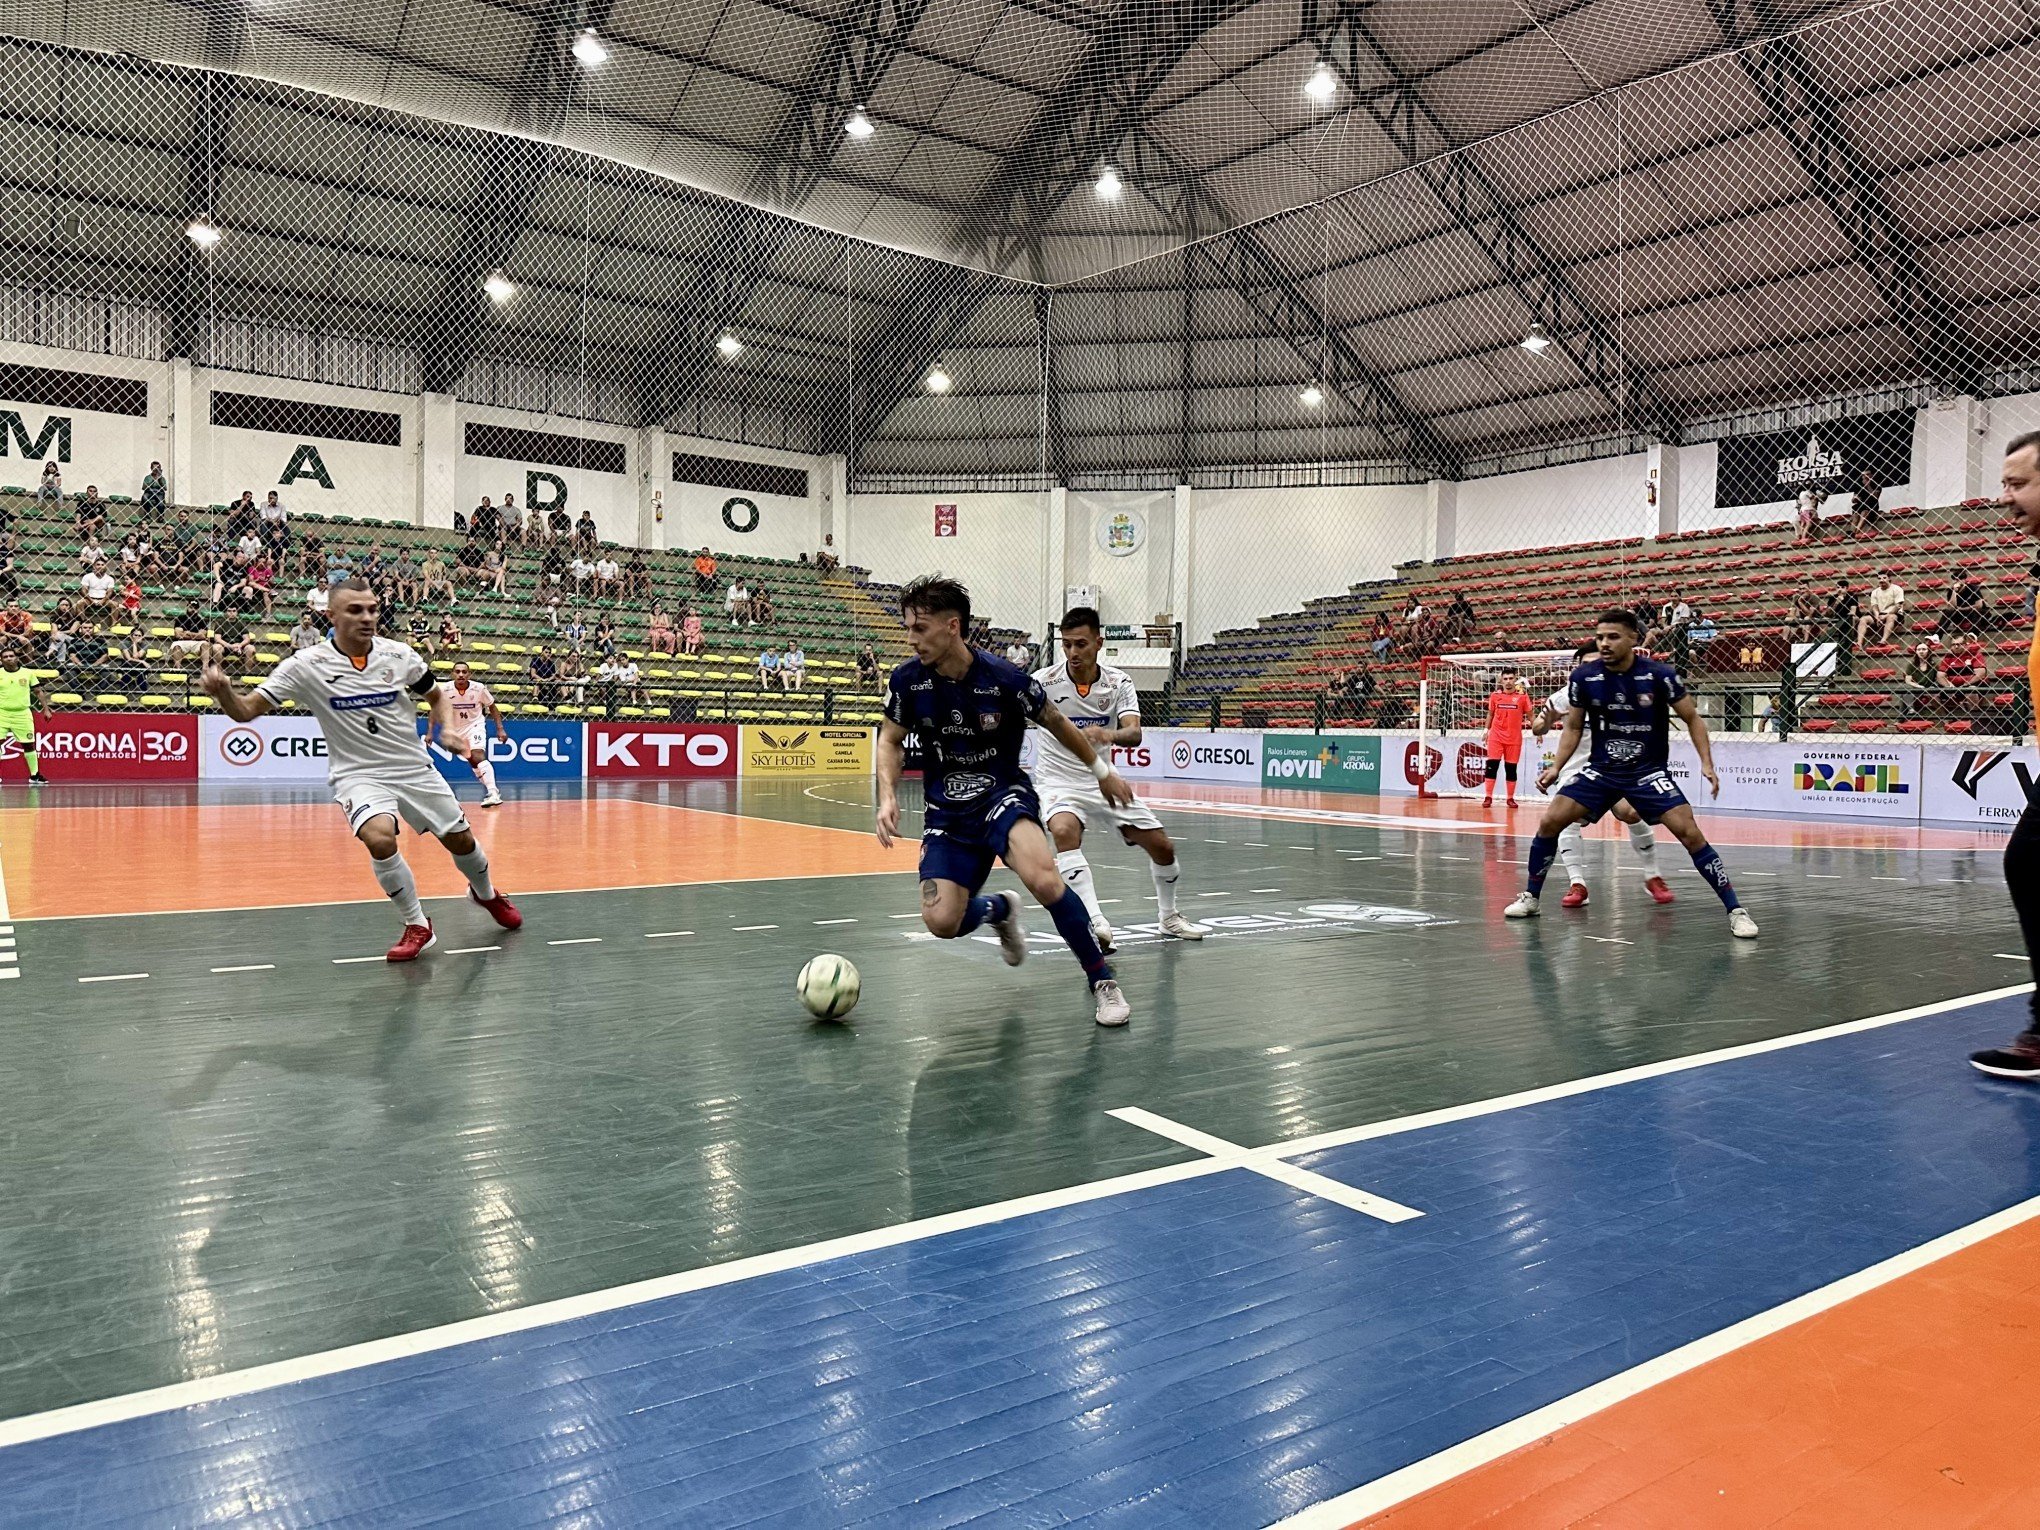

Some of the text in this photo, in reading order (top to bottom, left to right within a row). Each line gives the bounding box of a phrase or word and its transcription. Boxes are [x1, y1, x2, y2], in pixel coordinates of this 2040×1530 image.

[1777, 465, 1843, 484] NOSTRA
[366, 716, 379, 735] 8
[941, 725, 976, 736] CRESOL
[36, 732, 137, 752] KRONA
[143, 732, 188, 761] 30
[596, 732, 728, 767] KTO
[751, 752, 816, 766] SKY HOTÉIS
[1194, 747, 1254, 765] CRESOL
[1284, 748, 1307, 756] Lineares
[1803, 752, 1900, 761] GOVERNO FEDERAL
[1342, 761, 1375, 771] KRONA
[1410, 754, 1433, 767] RT
[1651, 777, 1675, 795] 16
[1736, 777, 1778, 785] ESPORTE
[1794, 763, 1910, 794] BRASIL
[1836, 796, 1899, 805] RECONSTRUÇÃO
